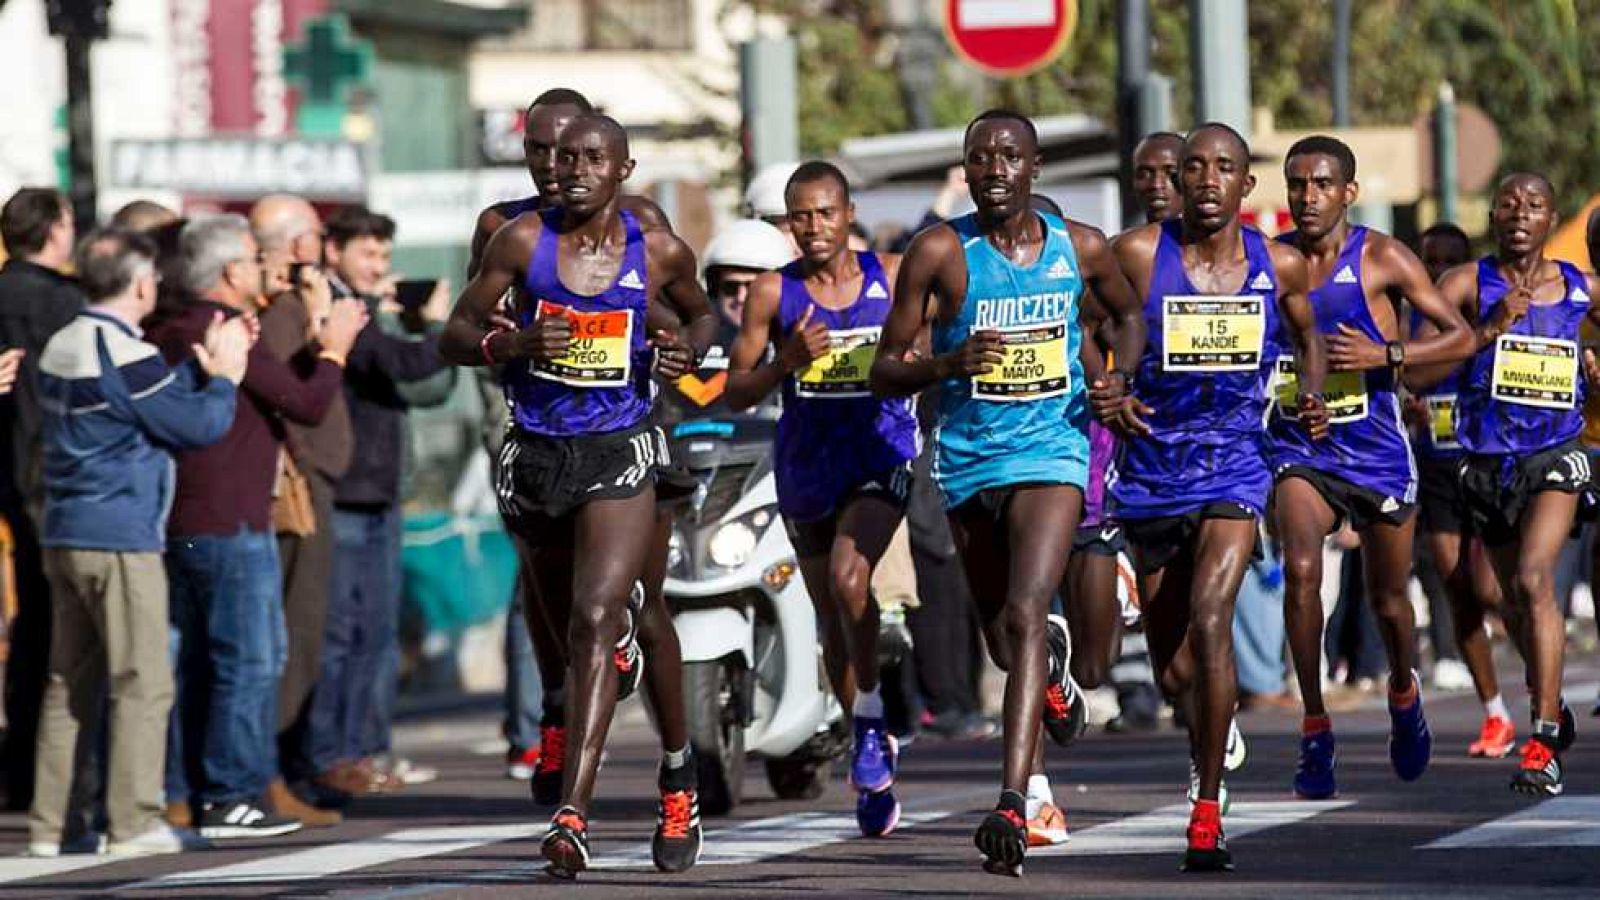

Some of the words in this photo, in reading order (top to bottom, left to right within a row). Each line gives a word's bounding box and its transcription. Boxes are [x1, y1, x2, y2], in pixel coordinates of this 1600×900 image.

[569, 318, 608, 335] ACE
[1206, 319, 1229, 336] 15
[1191, 335, 1240, 349] KANDIE
[569, 350, 608, 365] YEGO
[1012, 348, 1037, 364] 23
[1002, 364, 1045, 379] MAIYO
